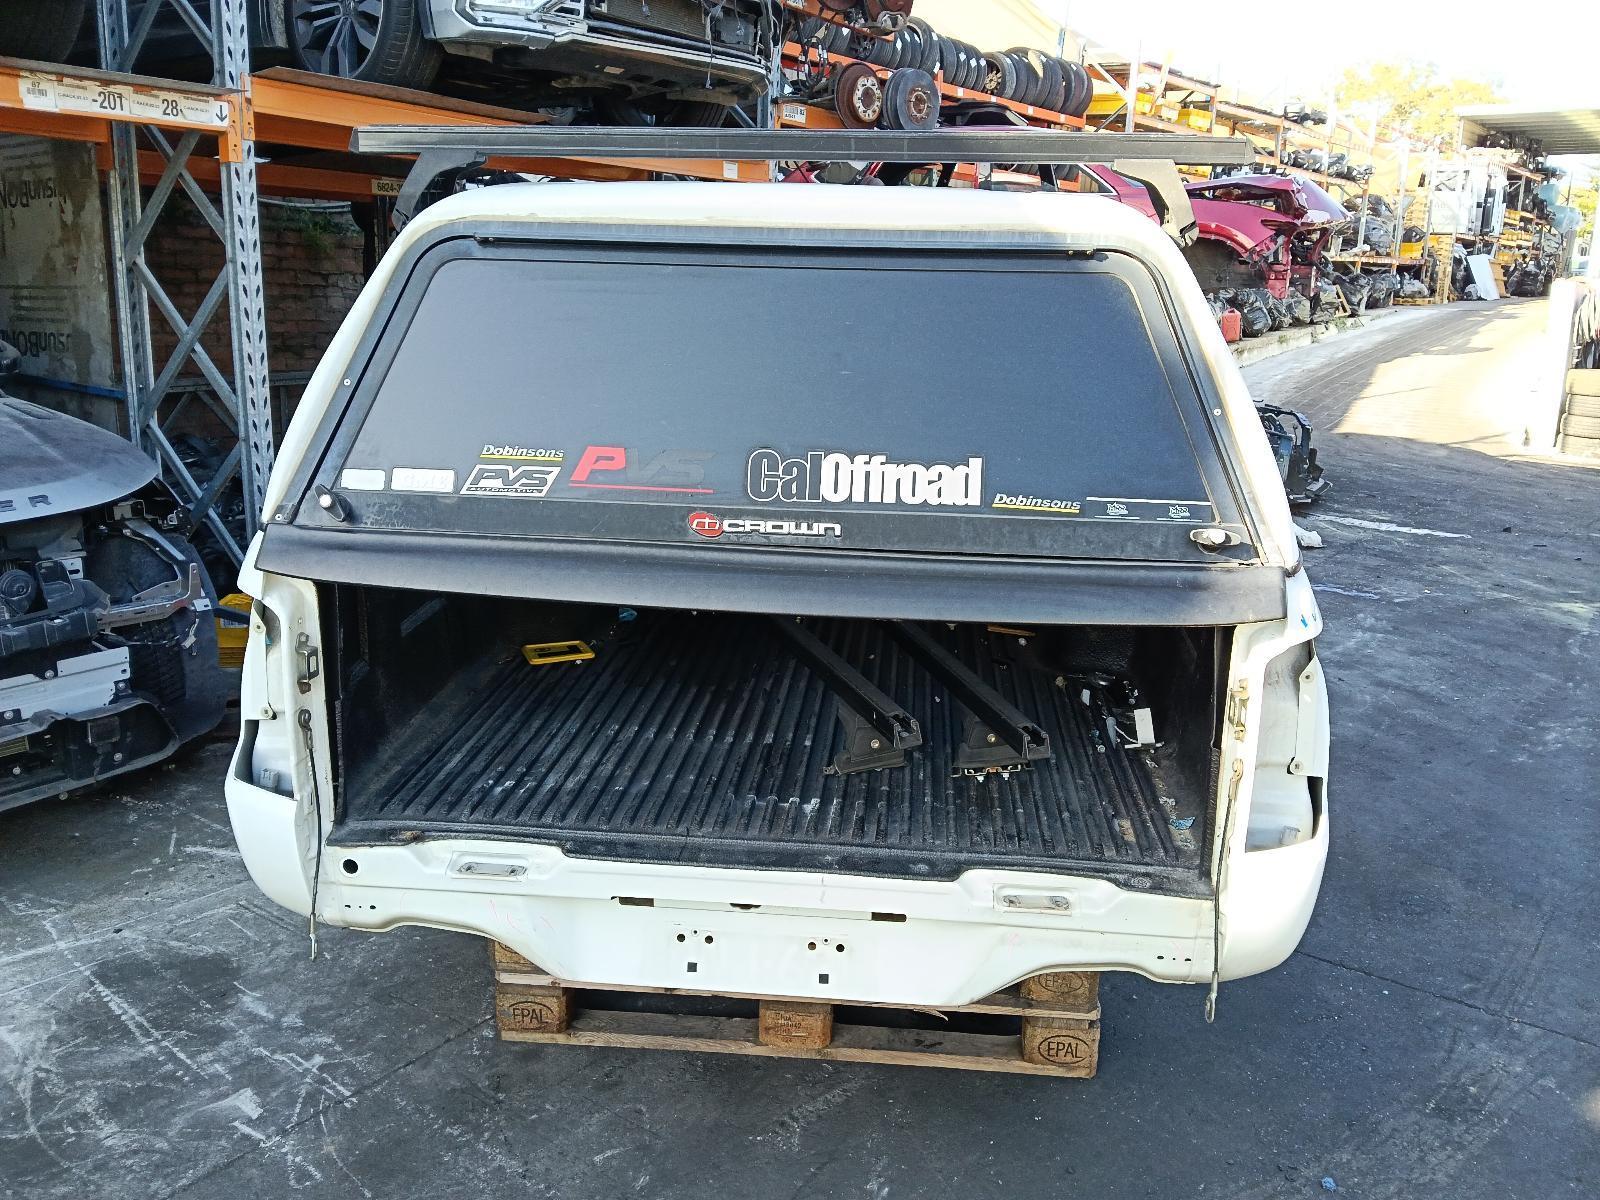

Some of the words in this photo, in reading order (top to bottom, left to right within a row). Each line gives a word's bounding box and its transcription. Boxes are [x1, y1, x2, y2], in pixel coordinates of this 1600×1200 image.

[161, 98, 179, 117] 28
[481, 444, 565, 458] Dobinsons
[469, 468, 554, 488] PVS
[748, 449, 983, 506] CalOffroad
[993, 493, 1081, 510] Dobinsons
[512, 1007, 549, 1024] EPAL
[1047, 1041, 1083, 1059] EPAL
